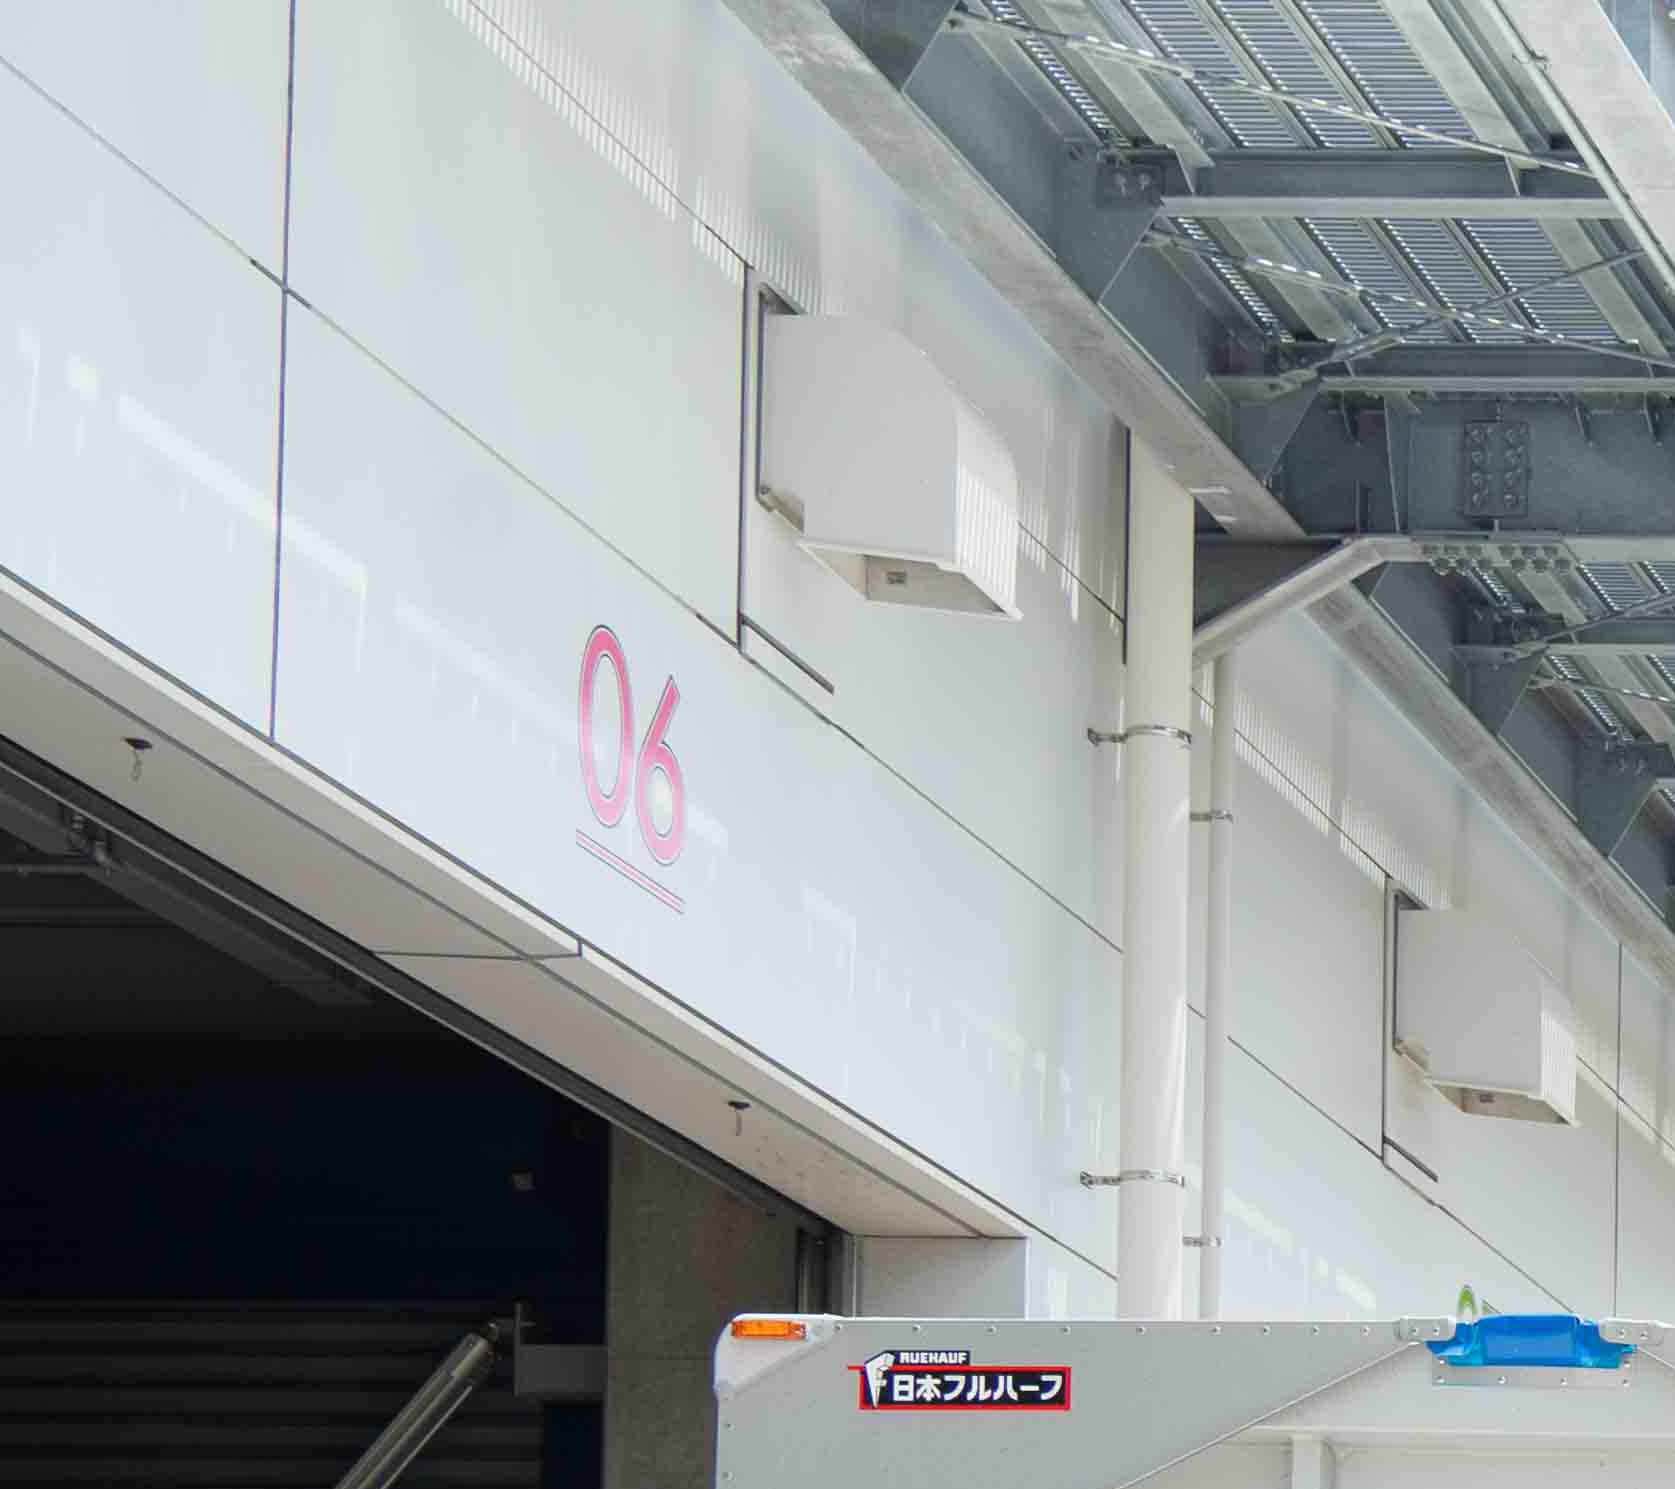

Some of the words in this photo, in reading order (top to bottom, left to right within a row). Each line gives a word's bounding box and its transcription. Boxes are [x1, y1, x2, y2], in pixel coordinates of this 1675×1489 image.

[579, 624, 685, 866] 06
[892, 1374, 1063, 1402] 日本フルハーフ
